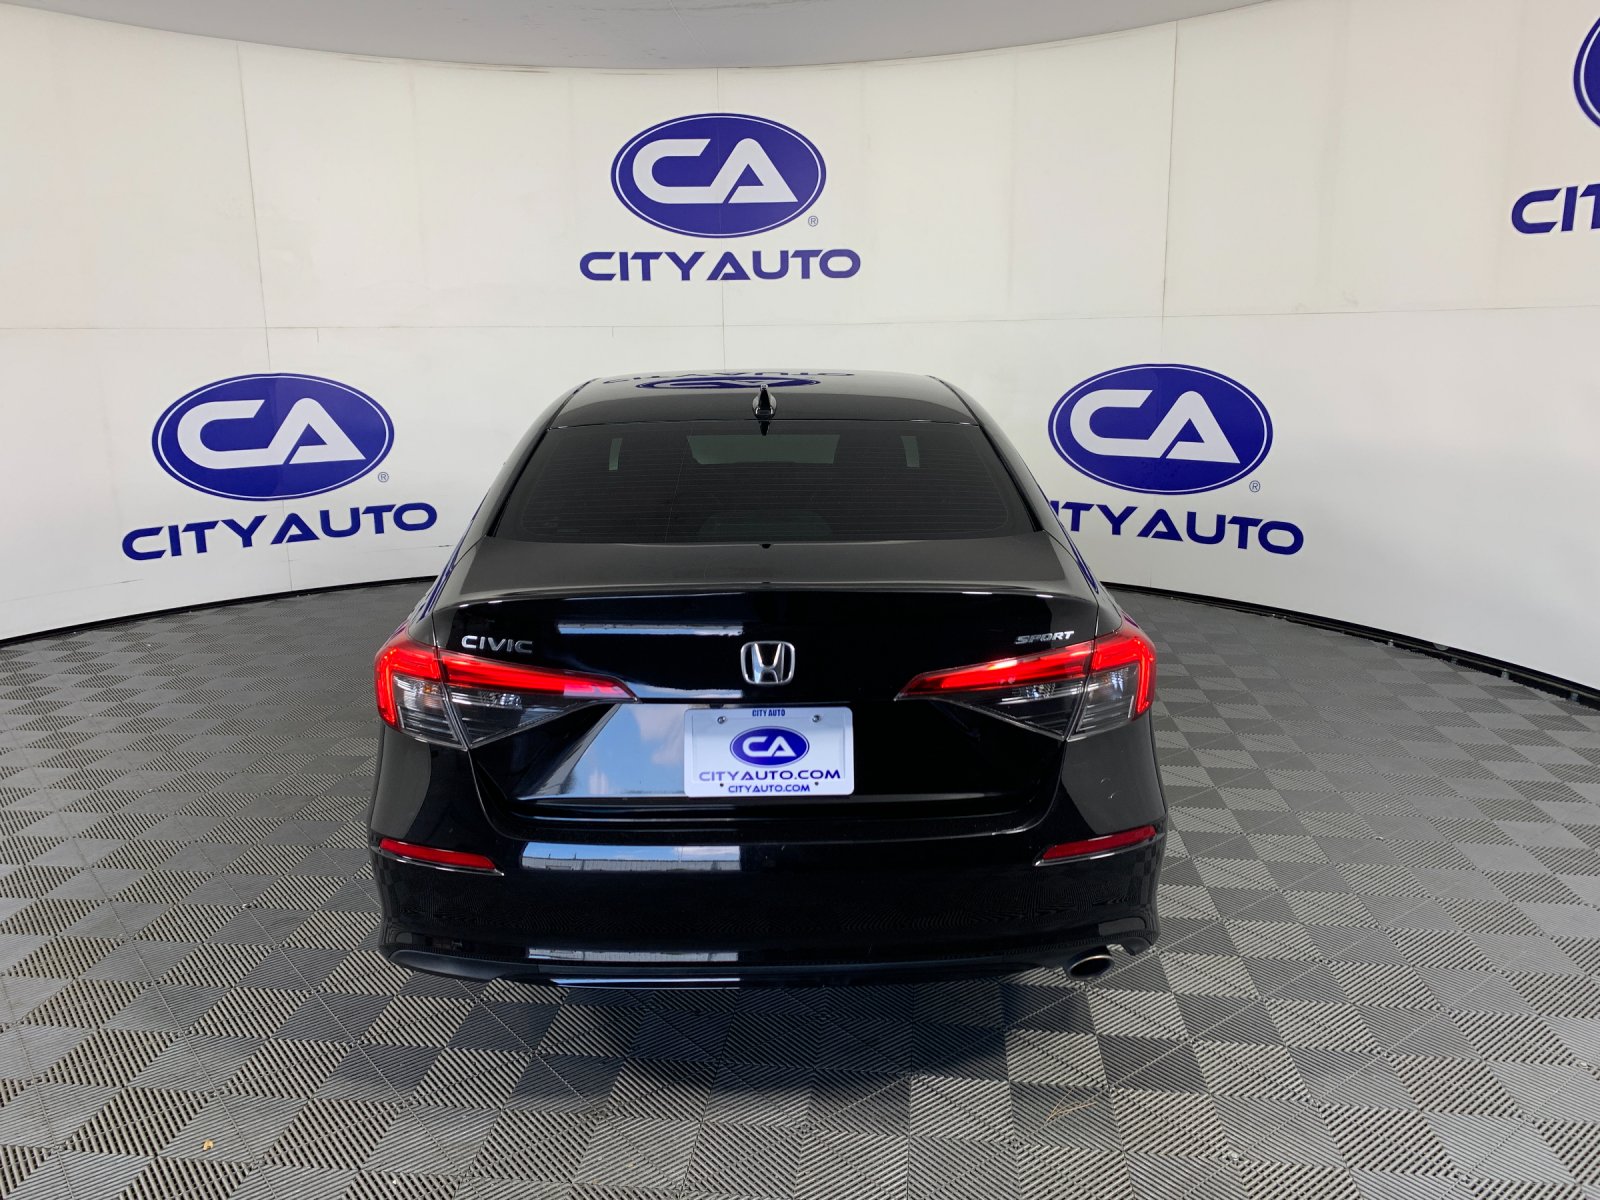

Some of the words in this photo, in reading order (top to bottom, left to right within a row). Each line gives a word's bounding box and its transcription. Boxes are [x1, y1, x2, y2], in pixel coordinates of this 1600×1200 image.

[632, 138, 799, 204] CA
[177, 397, 366, 470] CA
[1070, 388, 1241, 464] CA
[461, 634, 533, 654] CIVIC
[1014, 630, 1075, 645] SPORT
[752, 709, 768, 717] CITY
[768, 708, 786, 717] AUTO
[742, 735, 797, 758] CA
